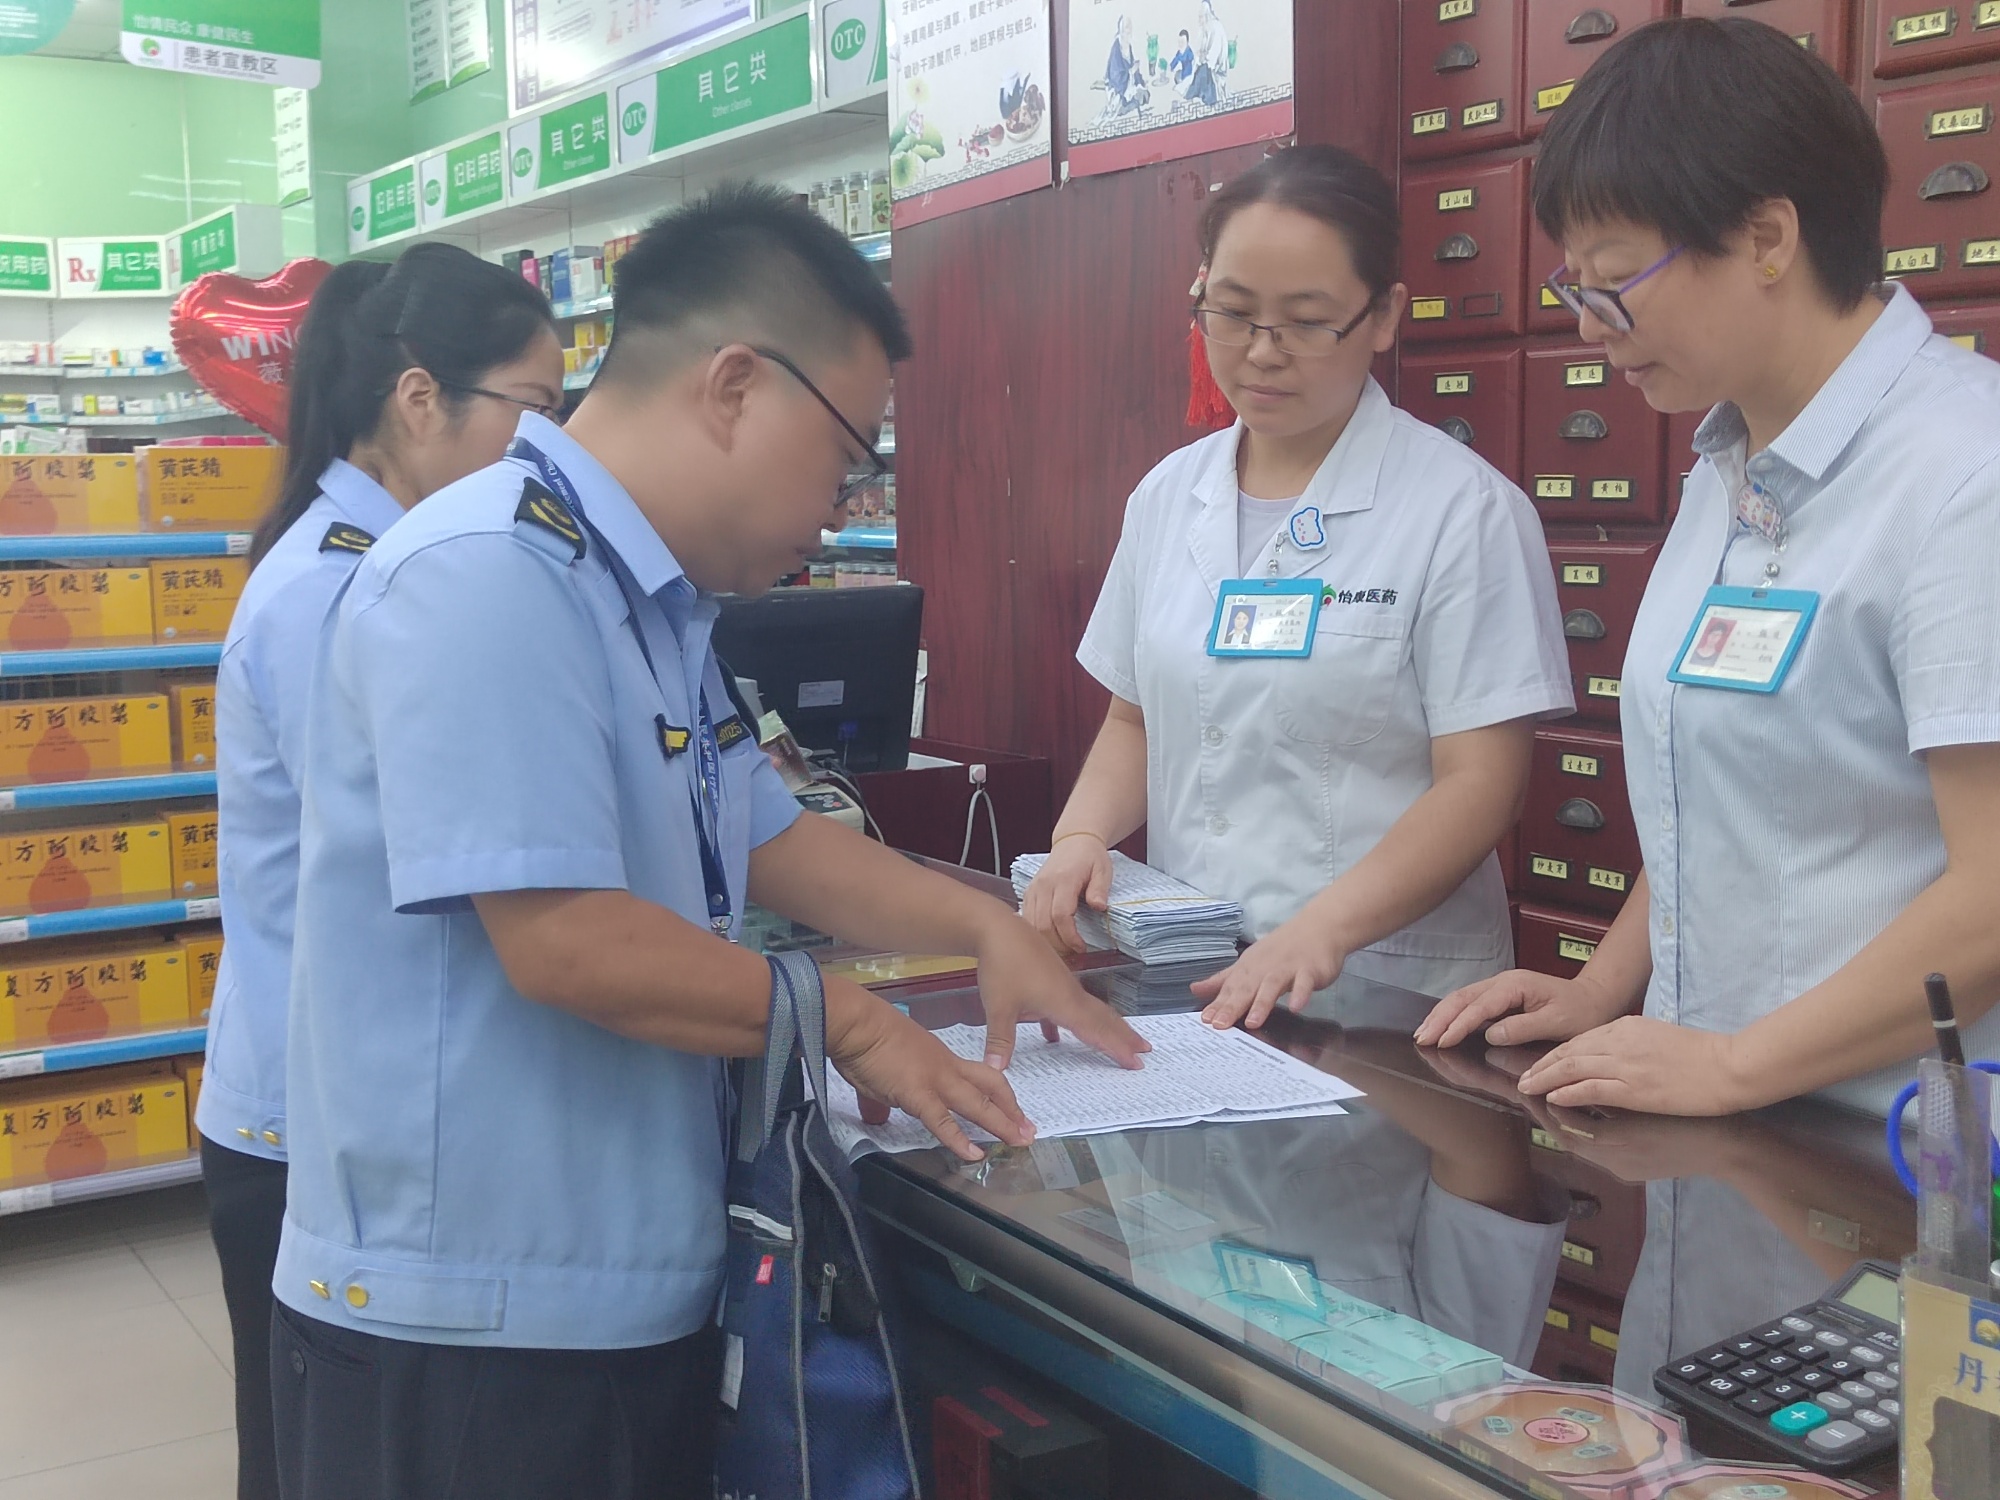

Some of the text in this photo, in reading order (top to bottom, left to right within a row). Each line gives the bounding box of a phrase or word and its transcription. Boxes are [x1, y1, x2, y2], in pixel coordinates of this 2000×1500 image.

[833, 22, 866, 54] OTC
[183, 45, 279, 75] 患者宣教区
[699, 50, 767, 103] 其它类
[712, 103, 730, 118] Other
[622, 106, 646, 130] OTC
[551, 114, 606, 157] 其它类
[513, 152, 534, 172] OTC
[107, 252, 160, 271] 其它类
[1338, 588, 1398, 606] 怡康医药
[191, 696, 215, 720] 黄
[1764, 1329, 1780, 1338] 7
[1738, 1341, 1752, 1349] 4
[1798, 1345, 1815, 1353] 8
[1710, 1352, 1723, 1361] 1
[1770, 1355, 1786, 1364] 5
[1680, 1364, 1696, 1373] 0
[1832, 1361, 1848, 1369] 9
[1741, 1368, 1757, 1377] 2
[1804, 1372, 1820, 1381] 6
[1710, 1378, 1733, 1390] 00
[1775, 1384, 1792, 1393] 3
